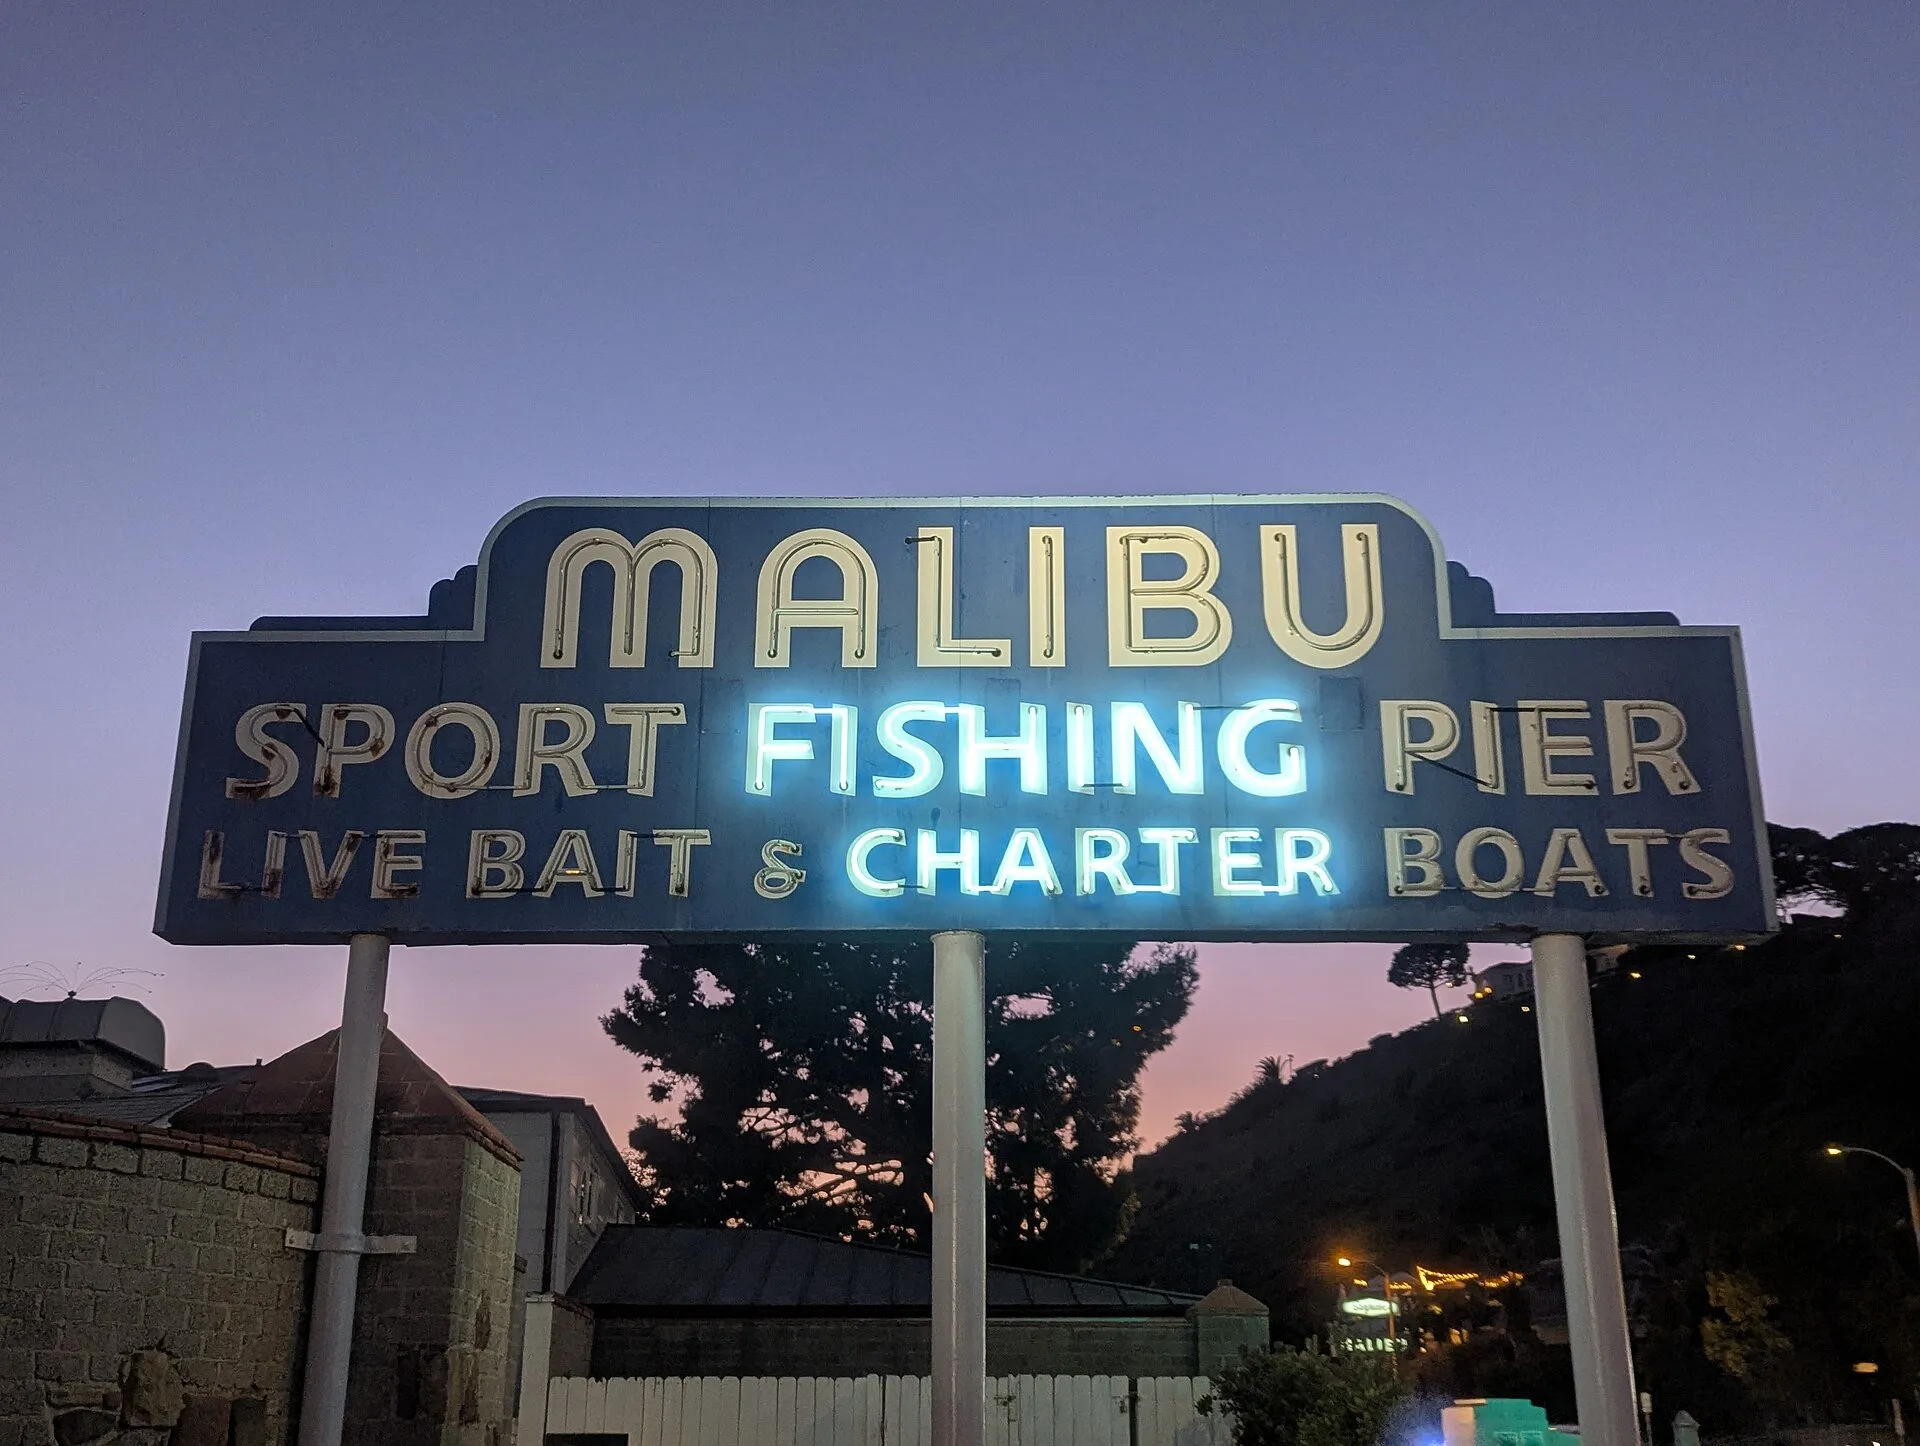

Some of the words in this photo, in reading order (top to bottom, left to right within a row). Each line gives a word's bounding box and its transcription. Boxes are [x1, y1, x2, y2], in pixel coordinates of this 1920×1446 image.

[540, 523, 1385, 669] MALIBU
[226, 702, 687, 799] SPORT
[745, 698, 1308, 798] FISHING
[1379, 700, 1701, 796] PIER
[198, 829, 427, 899] LIVE
[466, 829, 712, 899] BAIT
[754, 839, 808, 899] &
[846, 827, 1341, 897] CHARTER
[1384, 827, 1735, 900] BOATS
